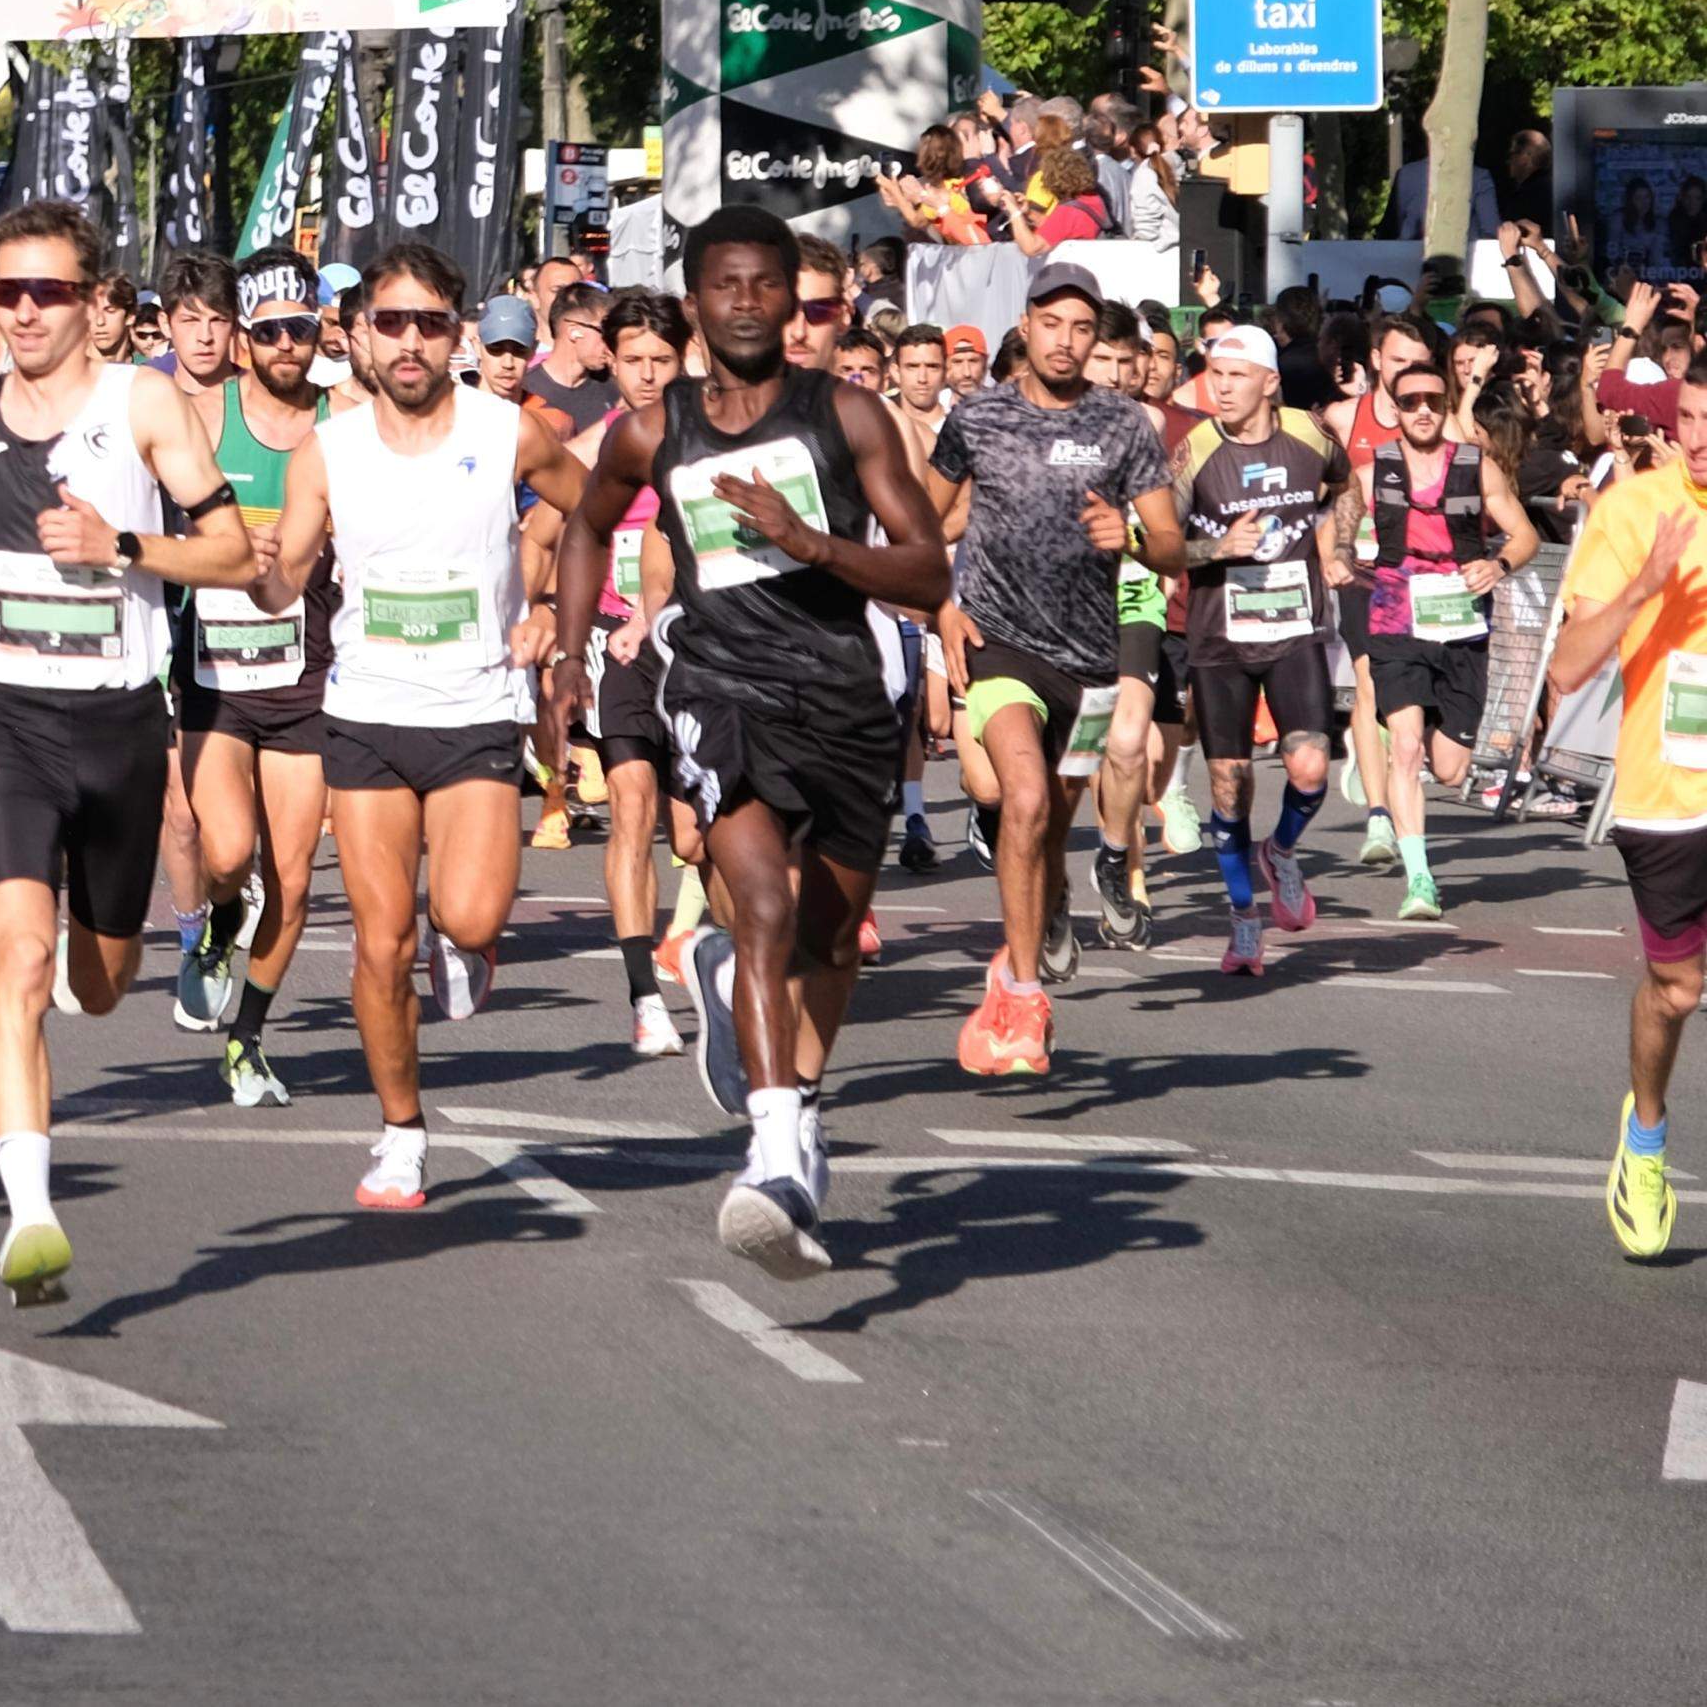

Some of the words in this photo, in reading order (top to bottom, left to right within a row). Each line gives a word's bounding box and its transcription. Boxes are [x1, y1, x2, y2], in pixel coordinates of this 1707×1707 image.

[727, 1, 753, 34] El
[752, 3, 813, 32] Corte
[1215, 59, 1232, 74] de
[1236, 59, 1278, 74] dilluns
[1283, 63, 1292, 74] a
[1297, 58, 1358, 74] divendres
[1249, 42, 1318, 57] Laborables
[401, 41, 449, 171] Corte
[55, 110, 92, 204] Corte
[726, 149, 752, 182] El
[751, 151, 812, 182] Corte
[396, 171, 439, 228] El
